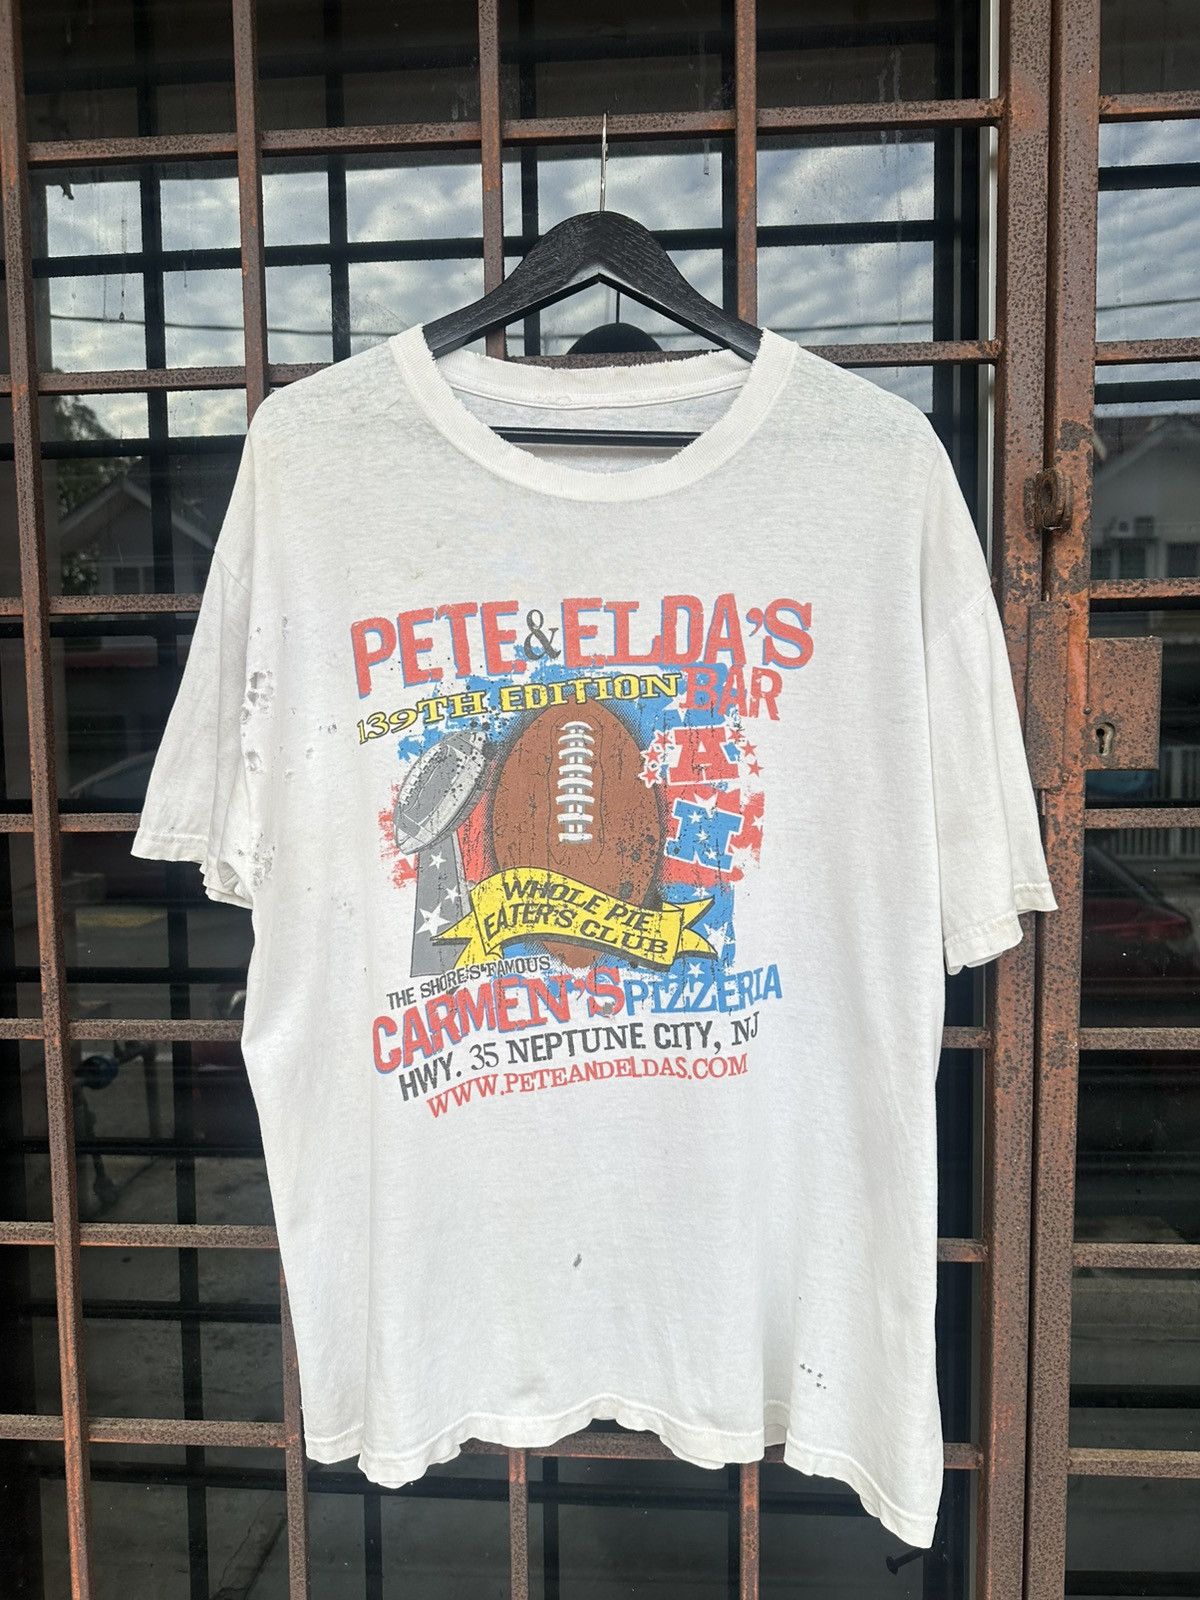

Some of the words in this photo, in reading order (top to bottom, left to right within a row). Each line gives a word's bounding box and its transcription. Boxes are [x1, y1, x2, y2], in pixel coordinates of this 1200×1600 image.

[350, 600, 527, 699] PETE
[524, 609, 561, 661] &
[561, 593, 815, 669] ELDA'S
[356, 690, 489, 745] 139TH
[499, 673, 683, 712] EDITION
[679, 665, 782, 722] BAR
[484, 902, 578, 942] EATER'S
[579, 919, 669, 954] CLUB
[503, 879, 607, 915] WHOLE
[603, 903, 656, 932] PIE
[371, 965, 626, 1075] CARMEN'S
[624, 963, 783, 1016] PIZZERIA
[386, 987, 417, 1010] THE
[399, 1050, 462, 1102] HWY.
[470, 1041, 500, 1072] 35
[507, 1022, 647, 1065] NEPTUNE
[653, 1020, 722, 1055] CITY,
[731, 1011, 760, 1046] NJ
[427, 1053, 749, 1118] WWW.PETEANDELDAS.COM
